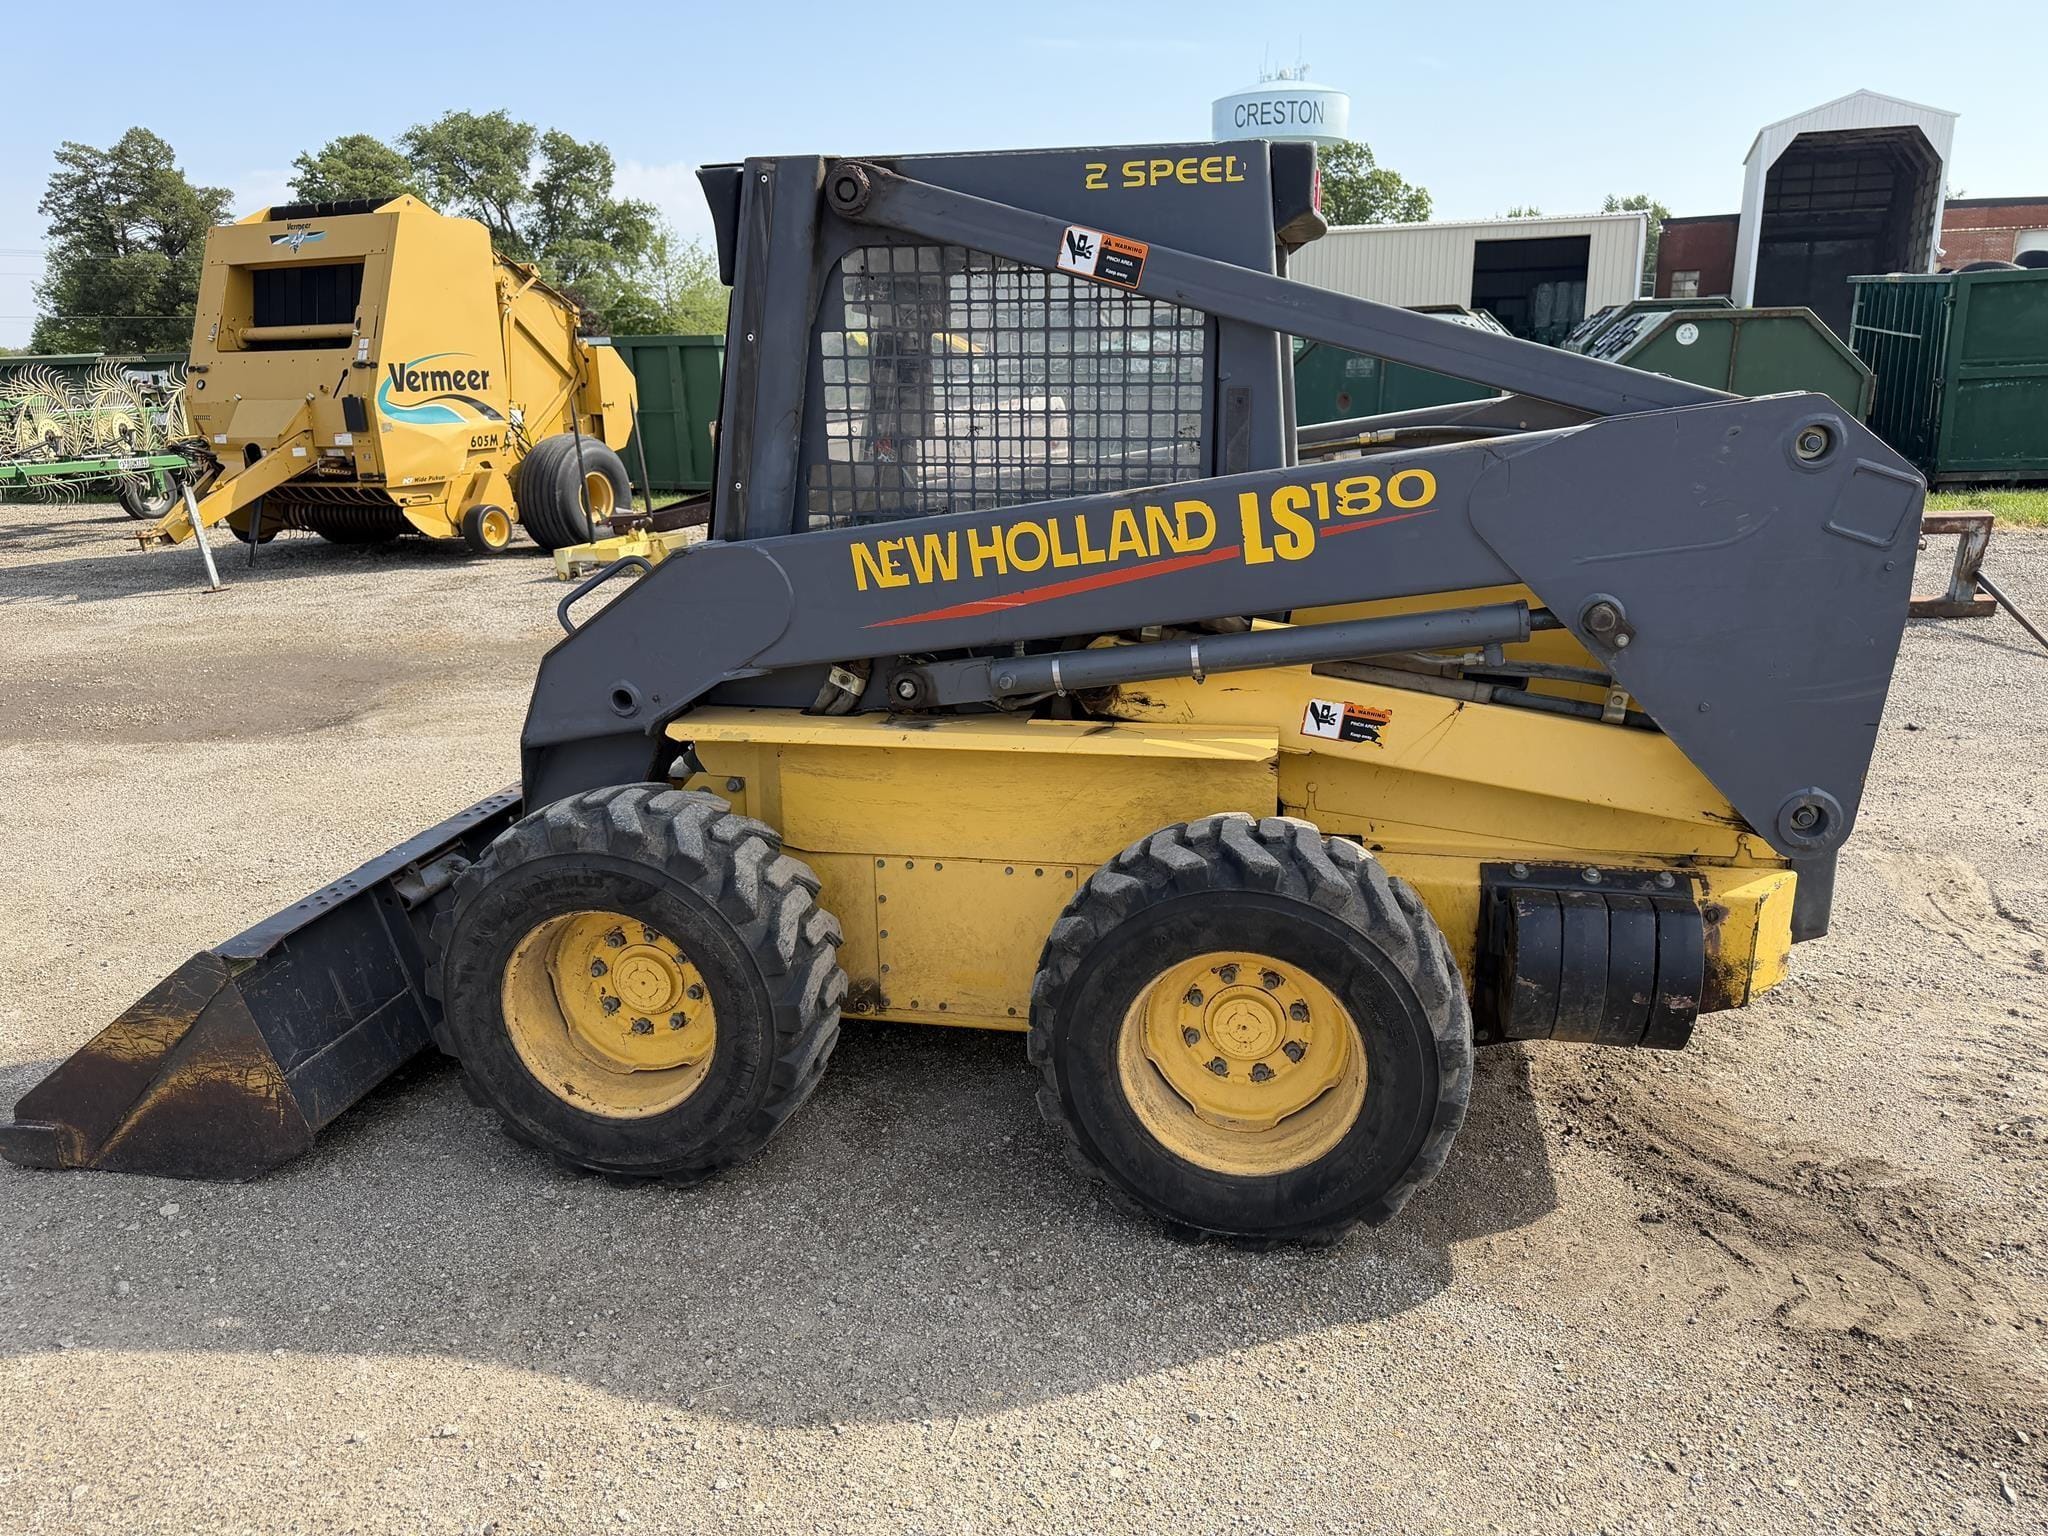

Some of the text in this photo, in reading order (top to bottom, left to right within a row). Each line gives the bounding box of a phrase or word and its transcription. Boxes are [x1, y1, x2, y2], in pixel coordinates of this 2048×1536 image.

[1234, 100, 1325, 128] CRESTON
[1085, 163, 1109, 189] 2
[286, 223, 312, 231] Vermeer
[1114, 242, 1143, 254] WARNING
[1106, 255, 1134, 267] PINCH AREA
[1105, 268, 1128, 280] Keep away
[387, 363, 490, 392] Vermeer
[470, 434, 499, 448] 605M
[849, 530, 958, 591] NEW
[966, 499, 1217, 578] HOLLAND
[1357, 709, 1386, 719] WARNING
[1350, 720, 1365, 728] PINCH
[1350, 731, 1362, 739] Keep
